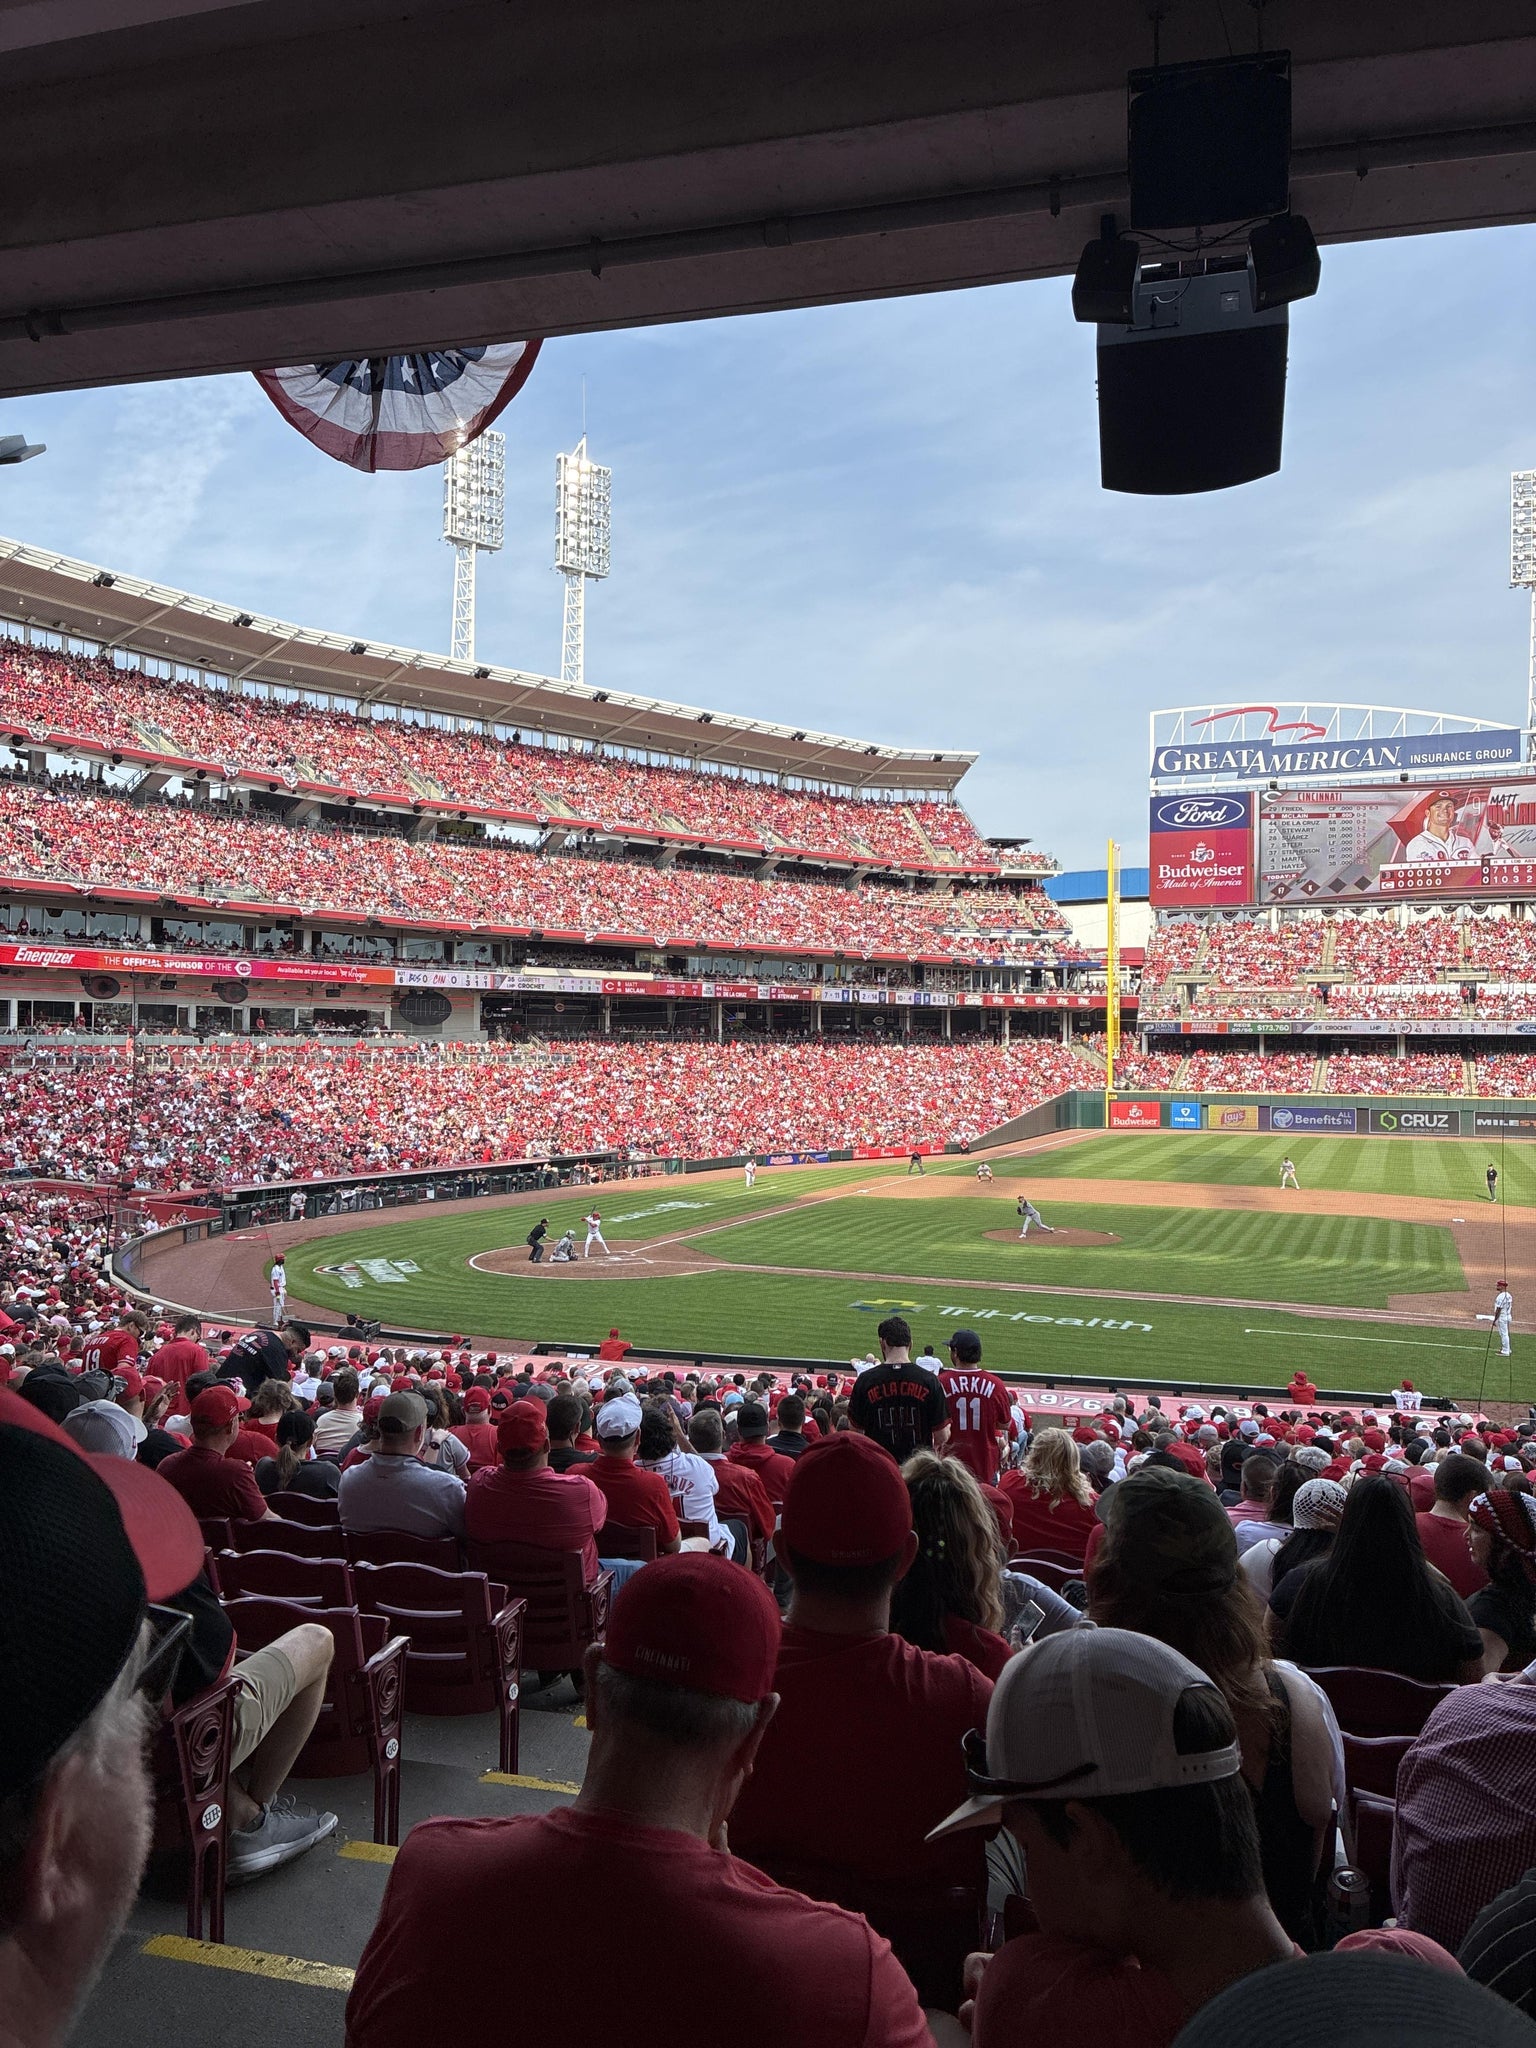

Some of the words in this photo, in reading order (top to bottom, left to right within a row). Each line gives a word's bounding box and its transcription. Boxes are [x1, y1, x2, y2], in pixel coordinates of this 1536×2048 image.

[1158, 749, 1254, 773] GREAT
[1410, 751, 1472, 764] INSURANCE
[1475, 748, 1513, 761] GROUP
[1298, 792, 1342, 802] CINCINNATI
[1490, 793, 1520, 807] MATT
[1174, 802, 1228, 823] Ford
[1158, 863, 1245, 878] Budweiser
[1156, 879, 1189, 889] Made
[1190, 878, 1200, 890] of
[1199, 877, 1242, 887] America
[1398, 880, 1404, 888] 0
[1417, 879, 1423, 887] 0
[1483, 876, 1489, 884] 0
[14, 948, 75, 967] Energizer
[104, 956, 120, 965] THE
[122, 958, 162, 968] OFFICIAL
[164, 961, 203, 970] SPONSOR
[205, 962, 216, 970] OF
[217, 963, 232, 972] THE
[348, 967, 368, 983] Kroger
[409, 974, 421, 982] BOS
[1113, 1117, 1158, 1126] Budweiser
[1295, 1114, 1342, 1125] Benefits
[1401, 1114, 1449, 1128] CRUZ
[936, 1304, 1153, 1333] TriHealth
[86, 1349, 101, 1371] 19
[868, 1386, 882, 1404] DE
[882, 1382, 898, 1398] LA
[901, 1382, 930, 1402] CRUZ
[940, 1376, 996, 1398] LARKIN
[1023, 1392, 1102, 1410] 1976
[1403, 1400, 1416, 1410] 54
[956, 1397, 981, 1431] 11
[204, 1808, 221, 1826] HH
